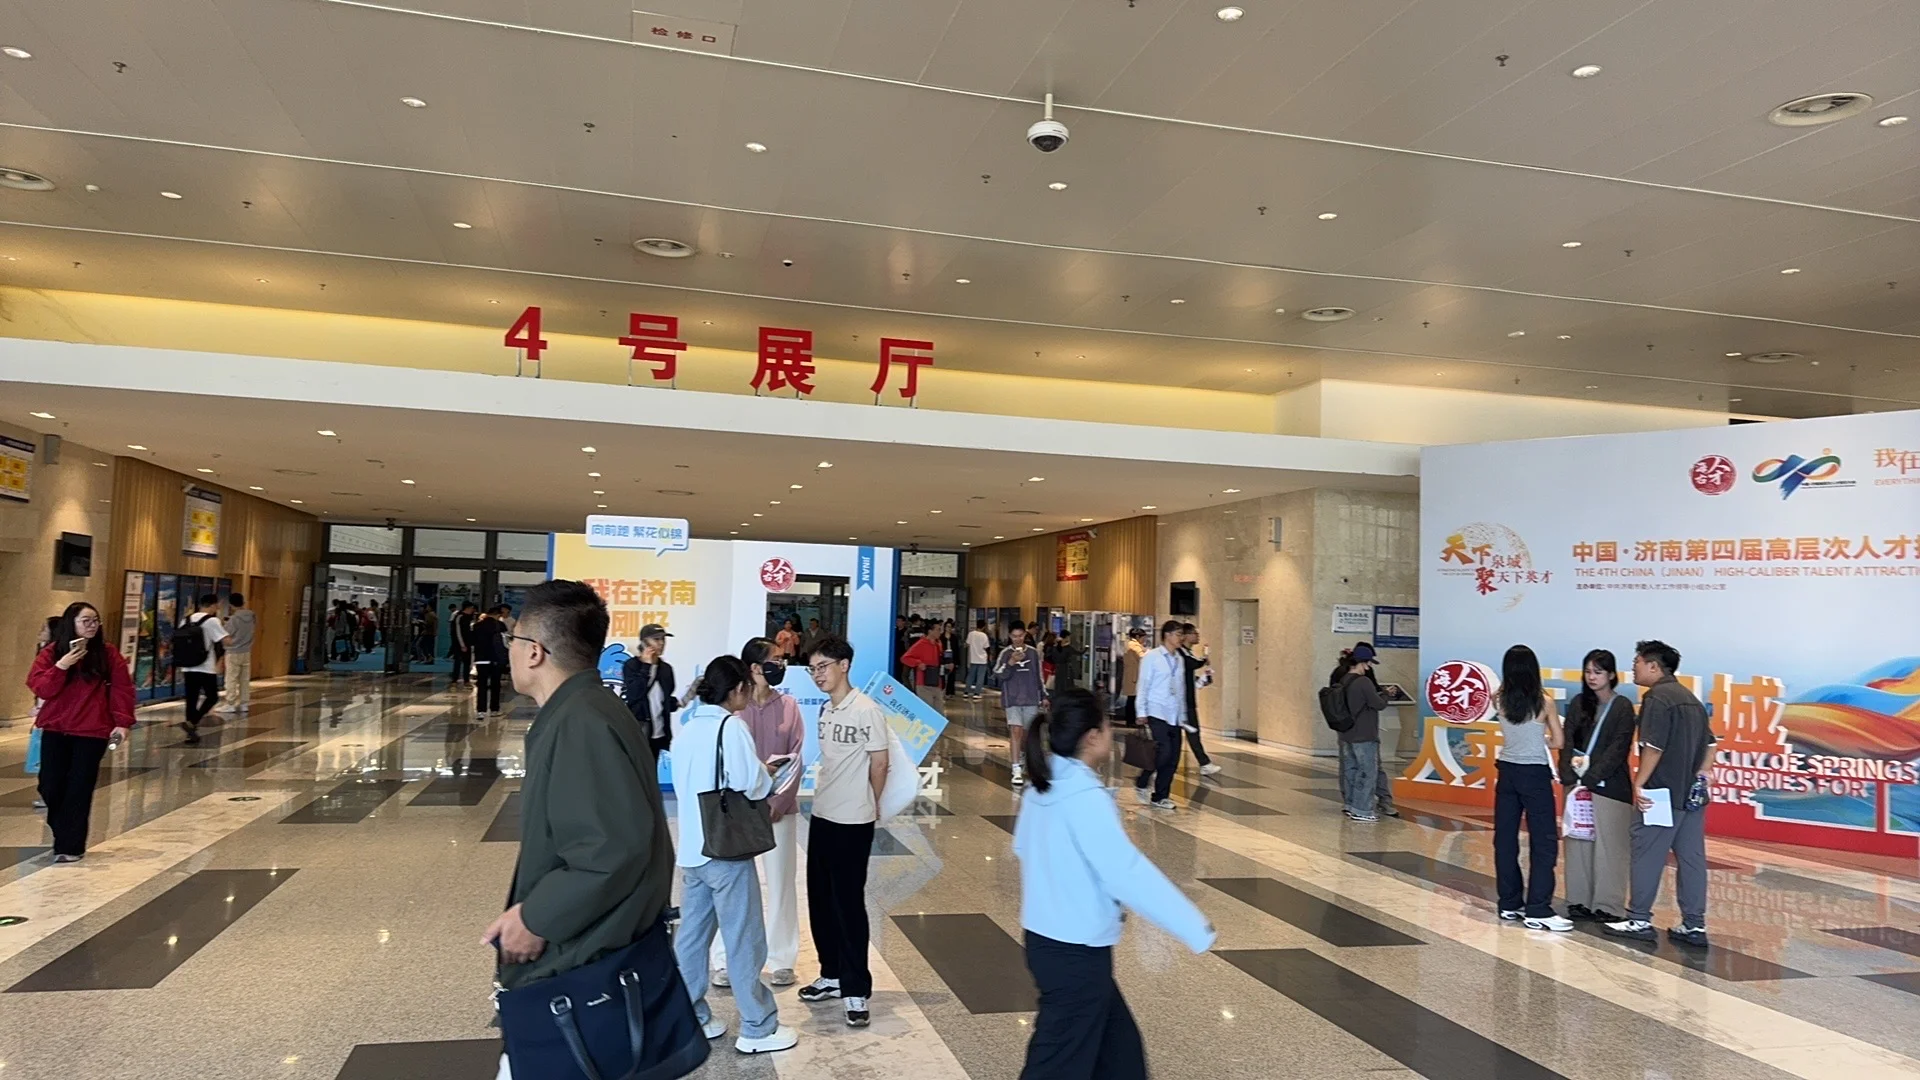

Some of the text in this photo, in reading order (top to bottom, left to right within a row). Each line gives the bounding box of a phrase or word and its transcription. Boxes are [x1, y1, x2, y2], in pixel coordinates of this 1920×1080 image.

[651, 26, 716, 43] 检修口
[504, 306, 934, 398] 4号展厅
[1572, 534, 1920, 563] 中国·济南第四届高层次人才
[861, 556, 871, 581] JINAN
[1575, 568, 1594, 577] THE
[1597, 568, 1618, 577] 4TH
[1620, 568, 1655, 577] CHINA
[1714, 567, 1799, 577] HIGH-CALIBER
[1803, 566, 1850, 577] TALENT
[1807, 755, 1919, 784] SPRINGS
[1816, 777, 1868, 798] FOR
